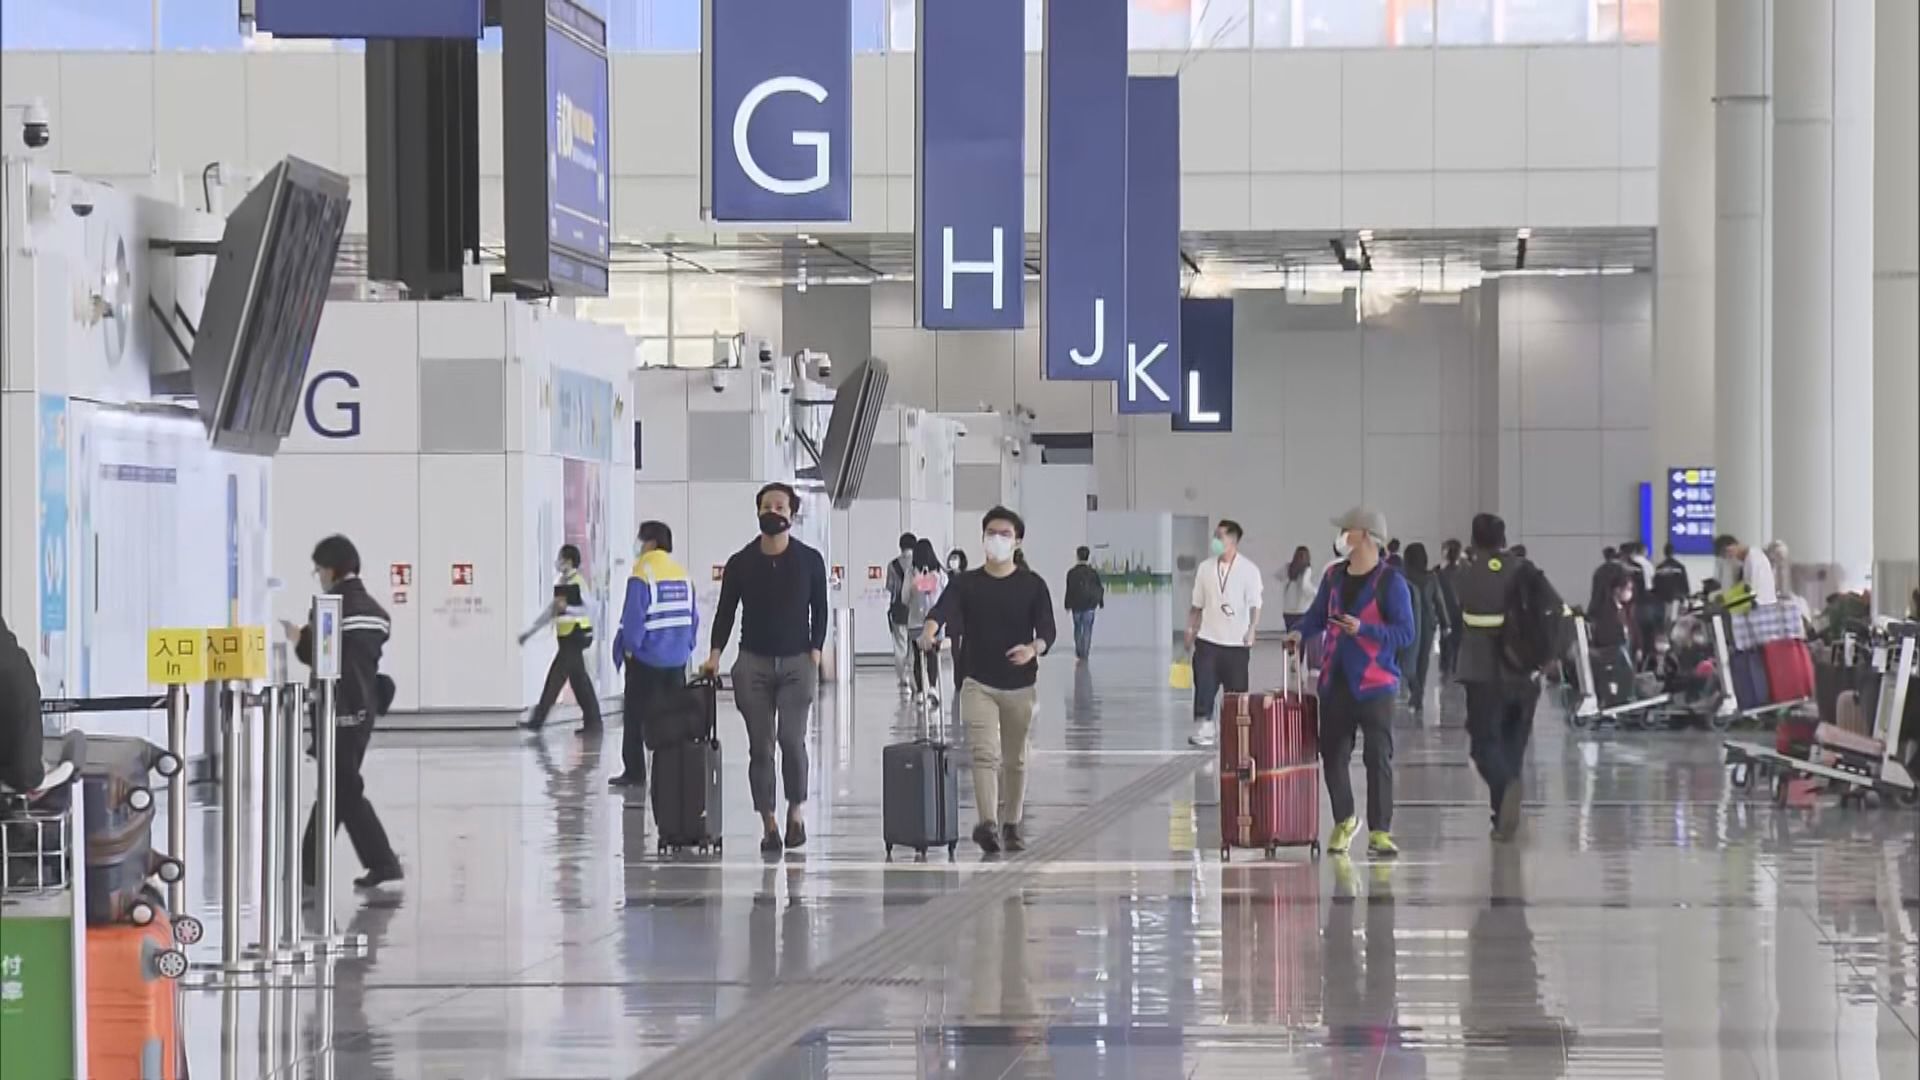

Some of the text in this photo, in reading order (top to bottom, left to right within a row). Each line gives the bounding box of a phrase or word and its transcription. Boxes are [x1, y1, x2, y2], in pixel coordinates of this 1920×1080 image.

[732, 76, 830, 195] G
[942, 227, 1004, 310] H
[1069, 298, 1105, 366] J
[1127, 343, 1171, 402] K
[1188, 371, 1221, 423] L
[304, 370, 361, 438] G
[155, 638, 193, 656] 入口
[167, 661, 181, 675] In
[213, 659, 226, 673] In
